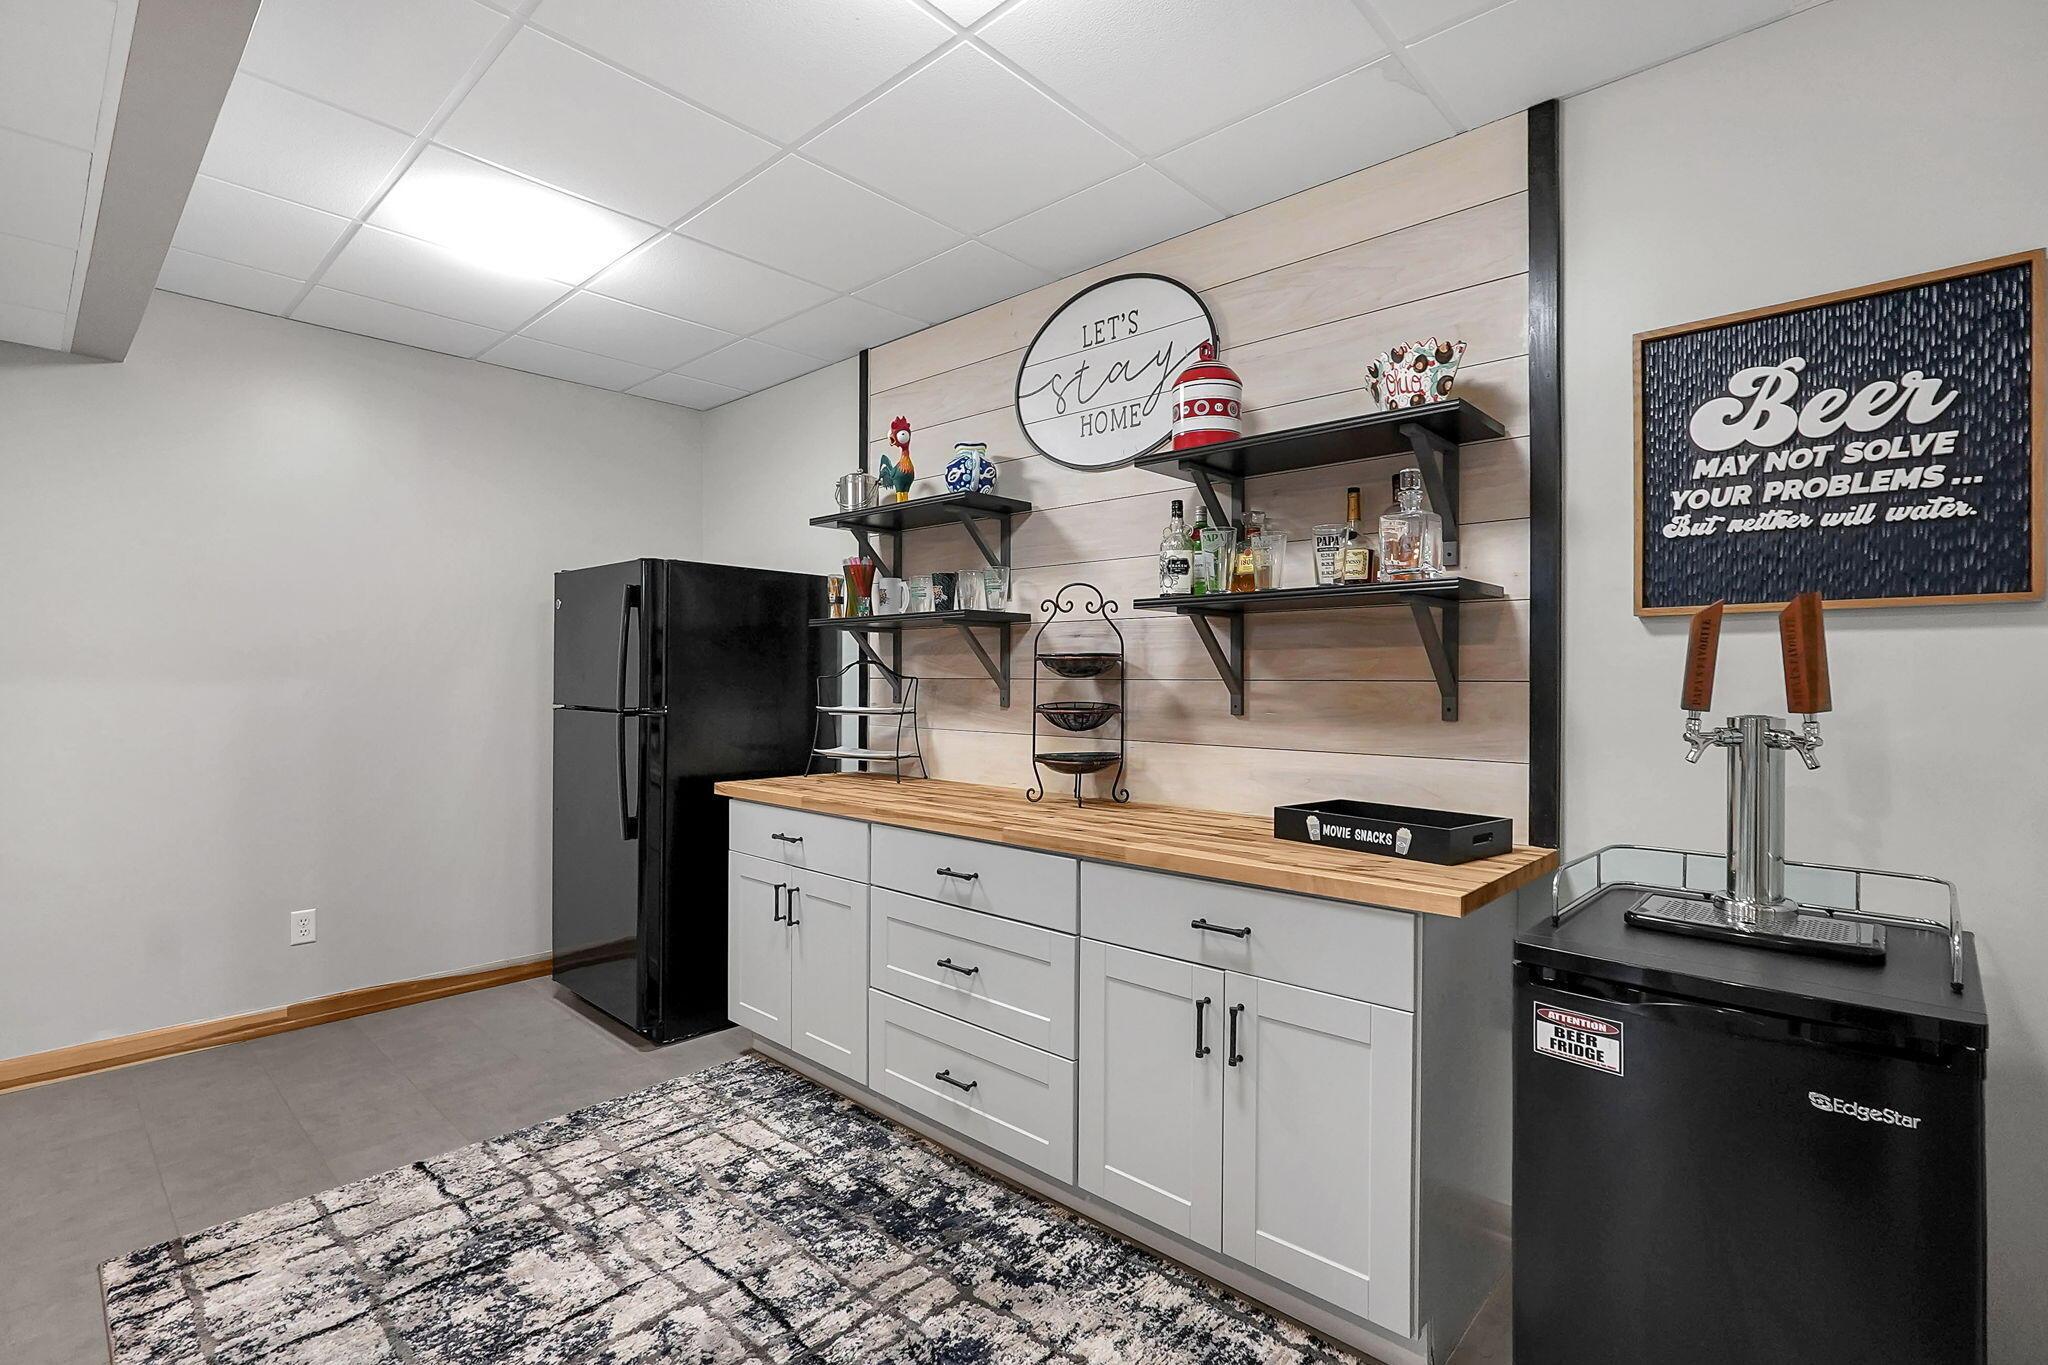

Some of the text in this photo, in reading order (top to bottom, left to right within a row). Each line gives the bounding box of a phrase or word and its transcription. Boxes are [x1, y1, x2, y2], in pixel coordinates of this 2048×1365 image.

[1082, 309, 1139, 348] LET'S
[1018, 338, 1210, 417] stay
[1689, 356, 1959, 452] Beer
[1080, 403, 1142, 438] HOME
[1692, 430, 1960, 480] MAY NOT SOLVE
[1671, 484, 1753, 511] YOUR
[1662, 495, 1978, 539] But neither will water.
[1316, 535, 1340, 547] PAPA
[1322, 823, 1393, 846] MOVIE SNACKS
[1547, 1011, 1607, 1032] ATTENTION
[1554, 1026, 1598, 1048] BEER
[1549, 1037, 1605, 1063] FRIDGE
